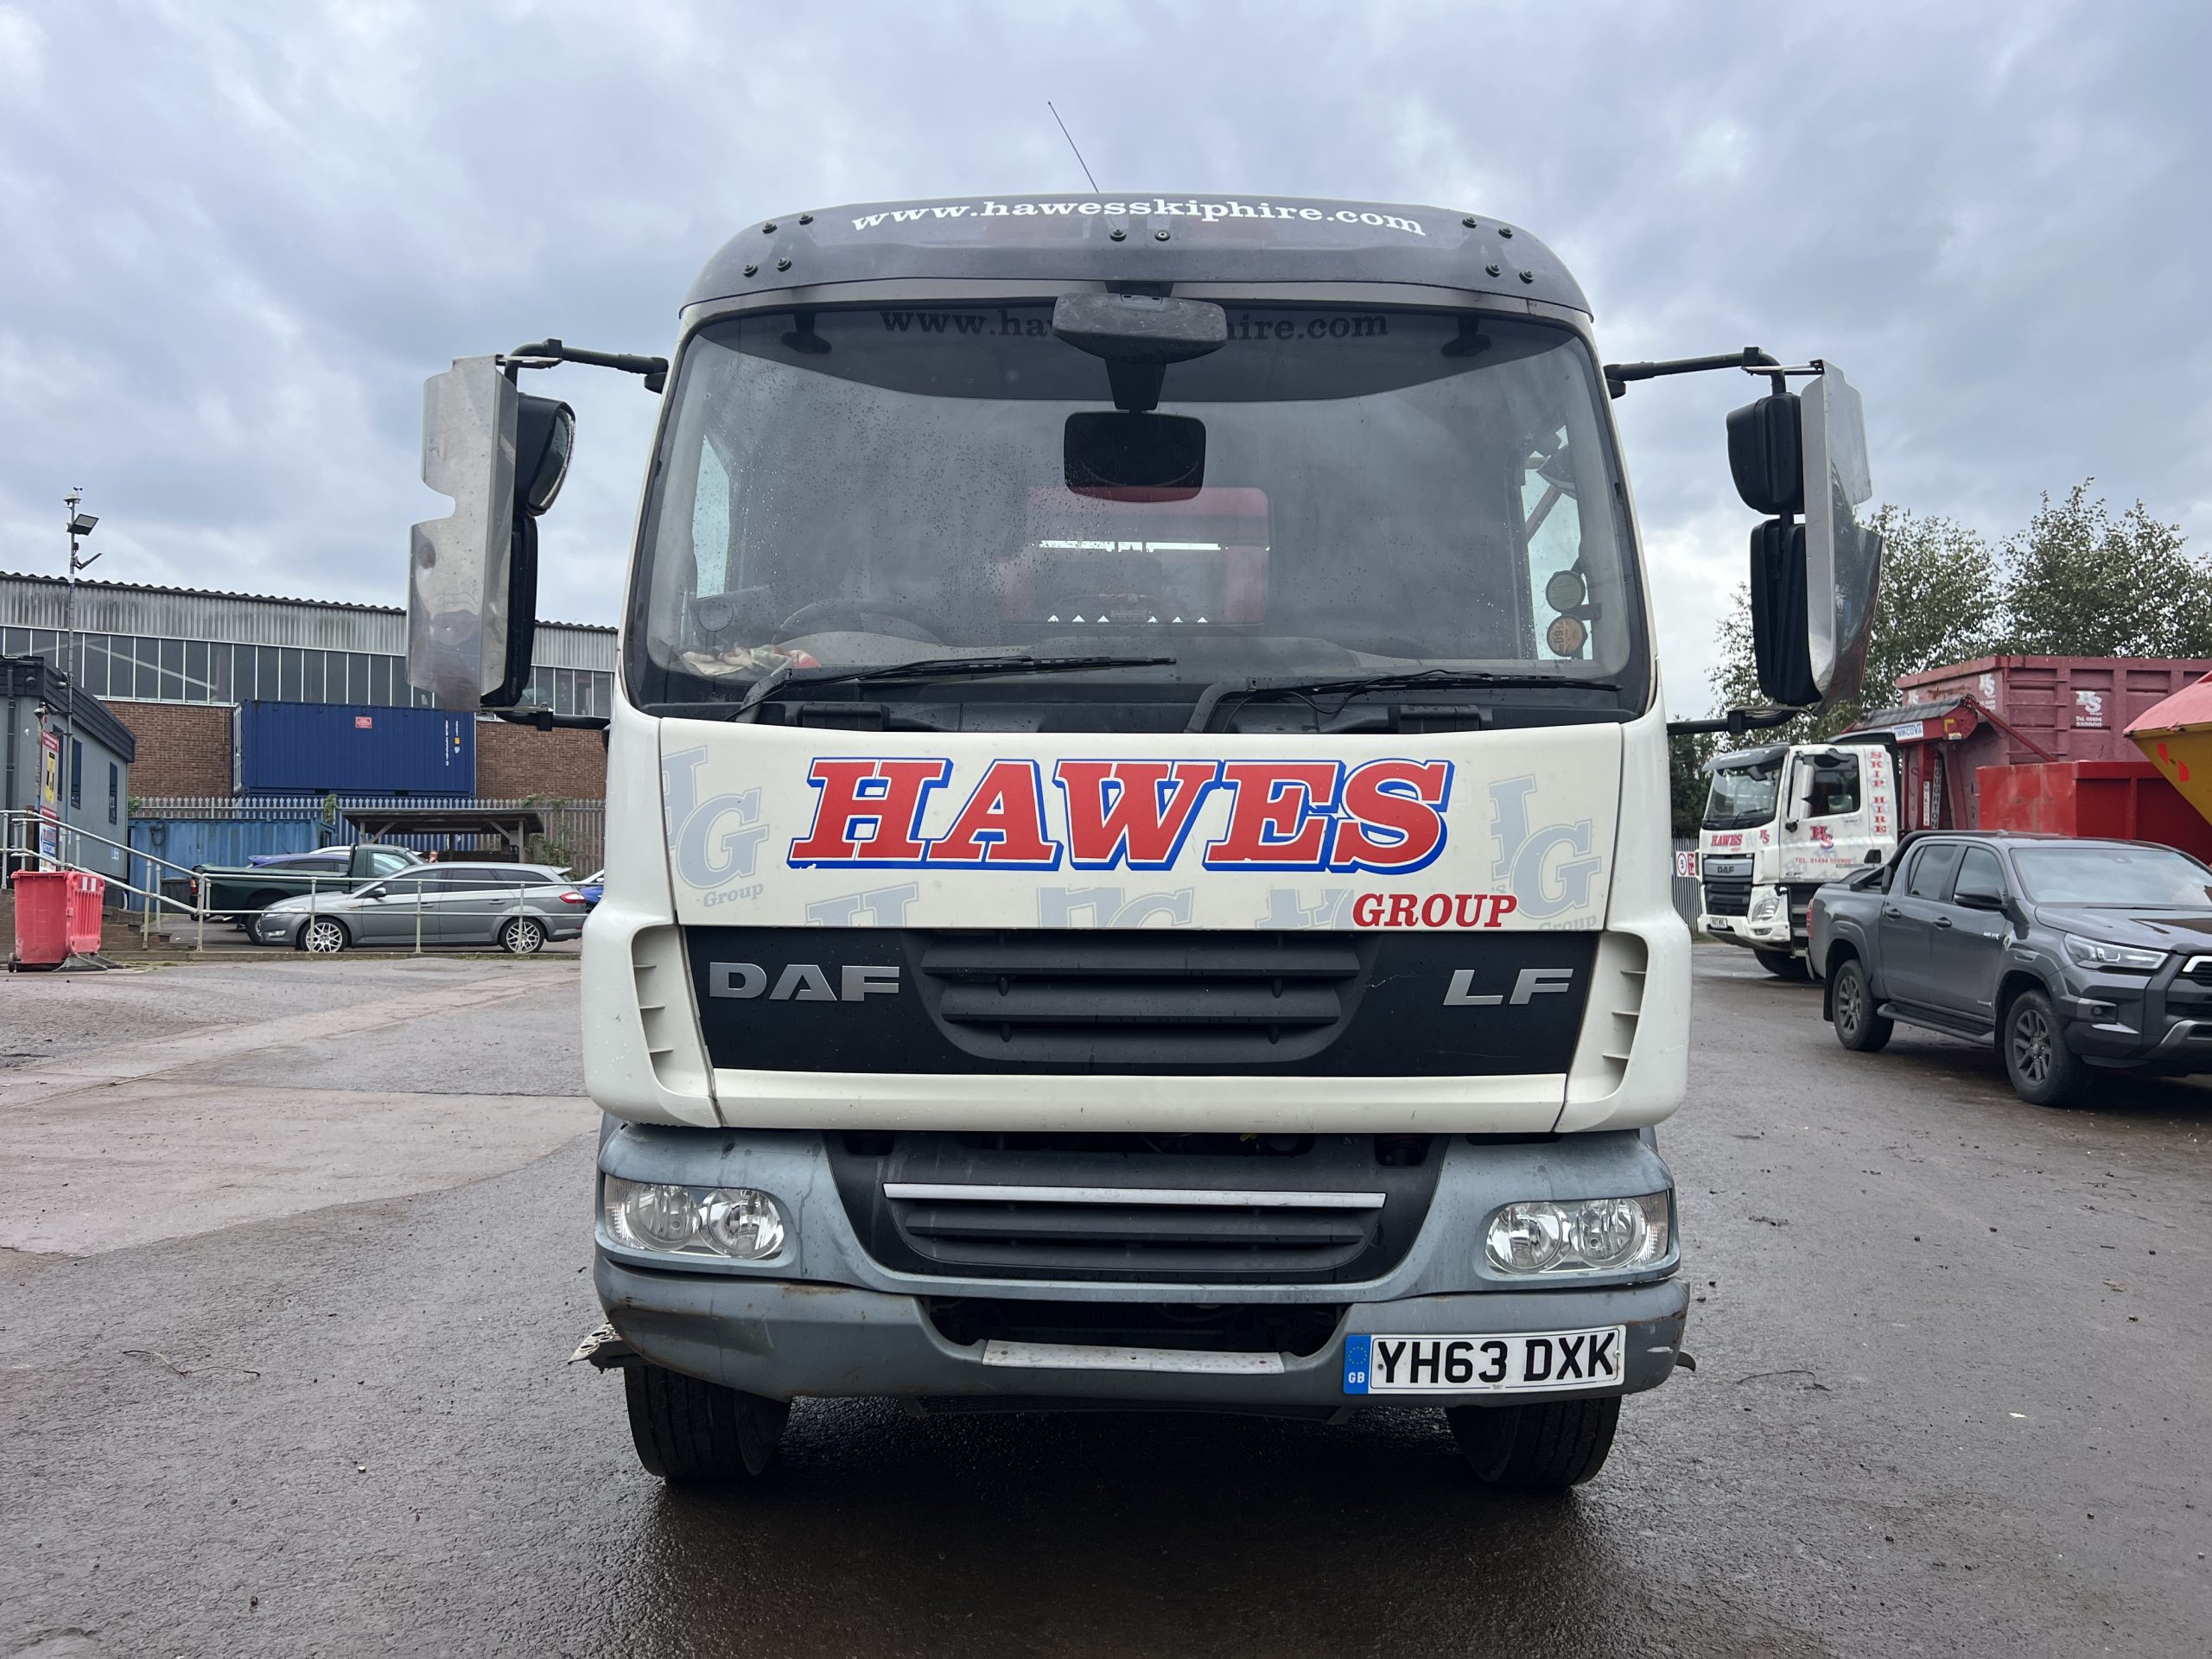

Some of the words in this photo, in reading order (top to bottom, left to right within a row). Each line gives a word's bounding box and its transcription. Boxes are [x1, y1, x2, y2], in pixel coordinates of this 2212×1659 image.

[851, 198, 1426, 237] www.hawesskiphire.com
[1870, 751, 1885, 788] SKIP
[787, 757, 1454, 874] HAWES
[1872, 796, 1887, 833] HIRE
[1711, 834, 1743, 847] HAWES
[702, 880, 765, 908] Group
[1352, 893, 1517, 927] GROUP
[709, 962, 900, 1001] DAF
[1443, 968, 1574, 1007] LF
[1377, 1340, 1509, 1383] YH63
[1523, 1332, 1616, 1382] DXK
[1348, 1371, 1365, 1383] GB
